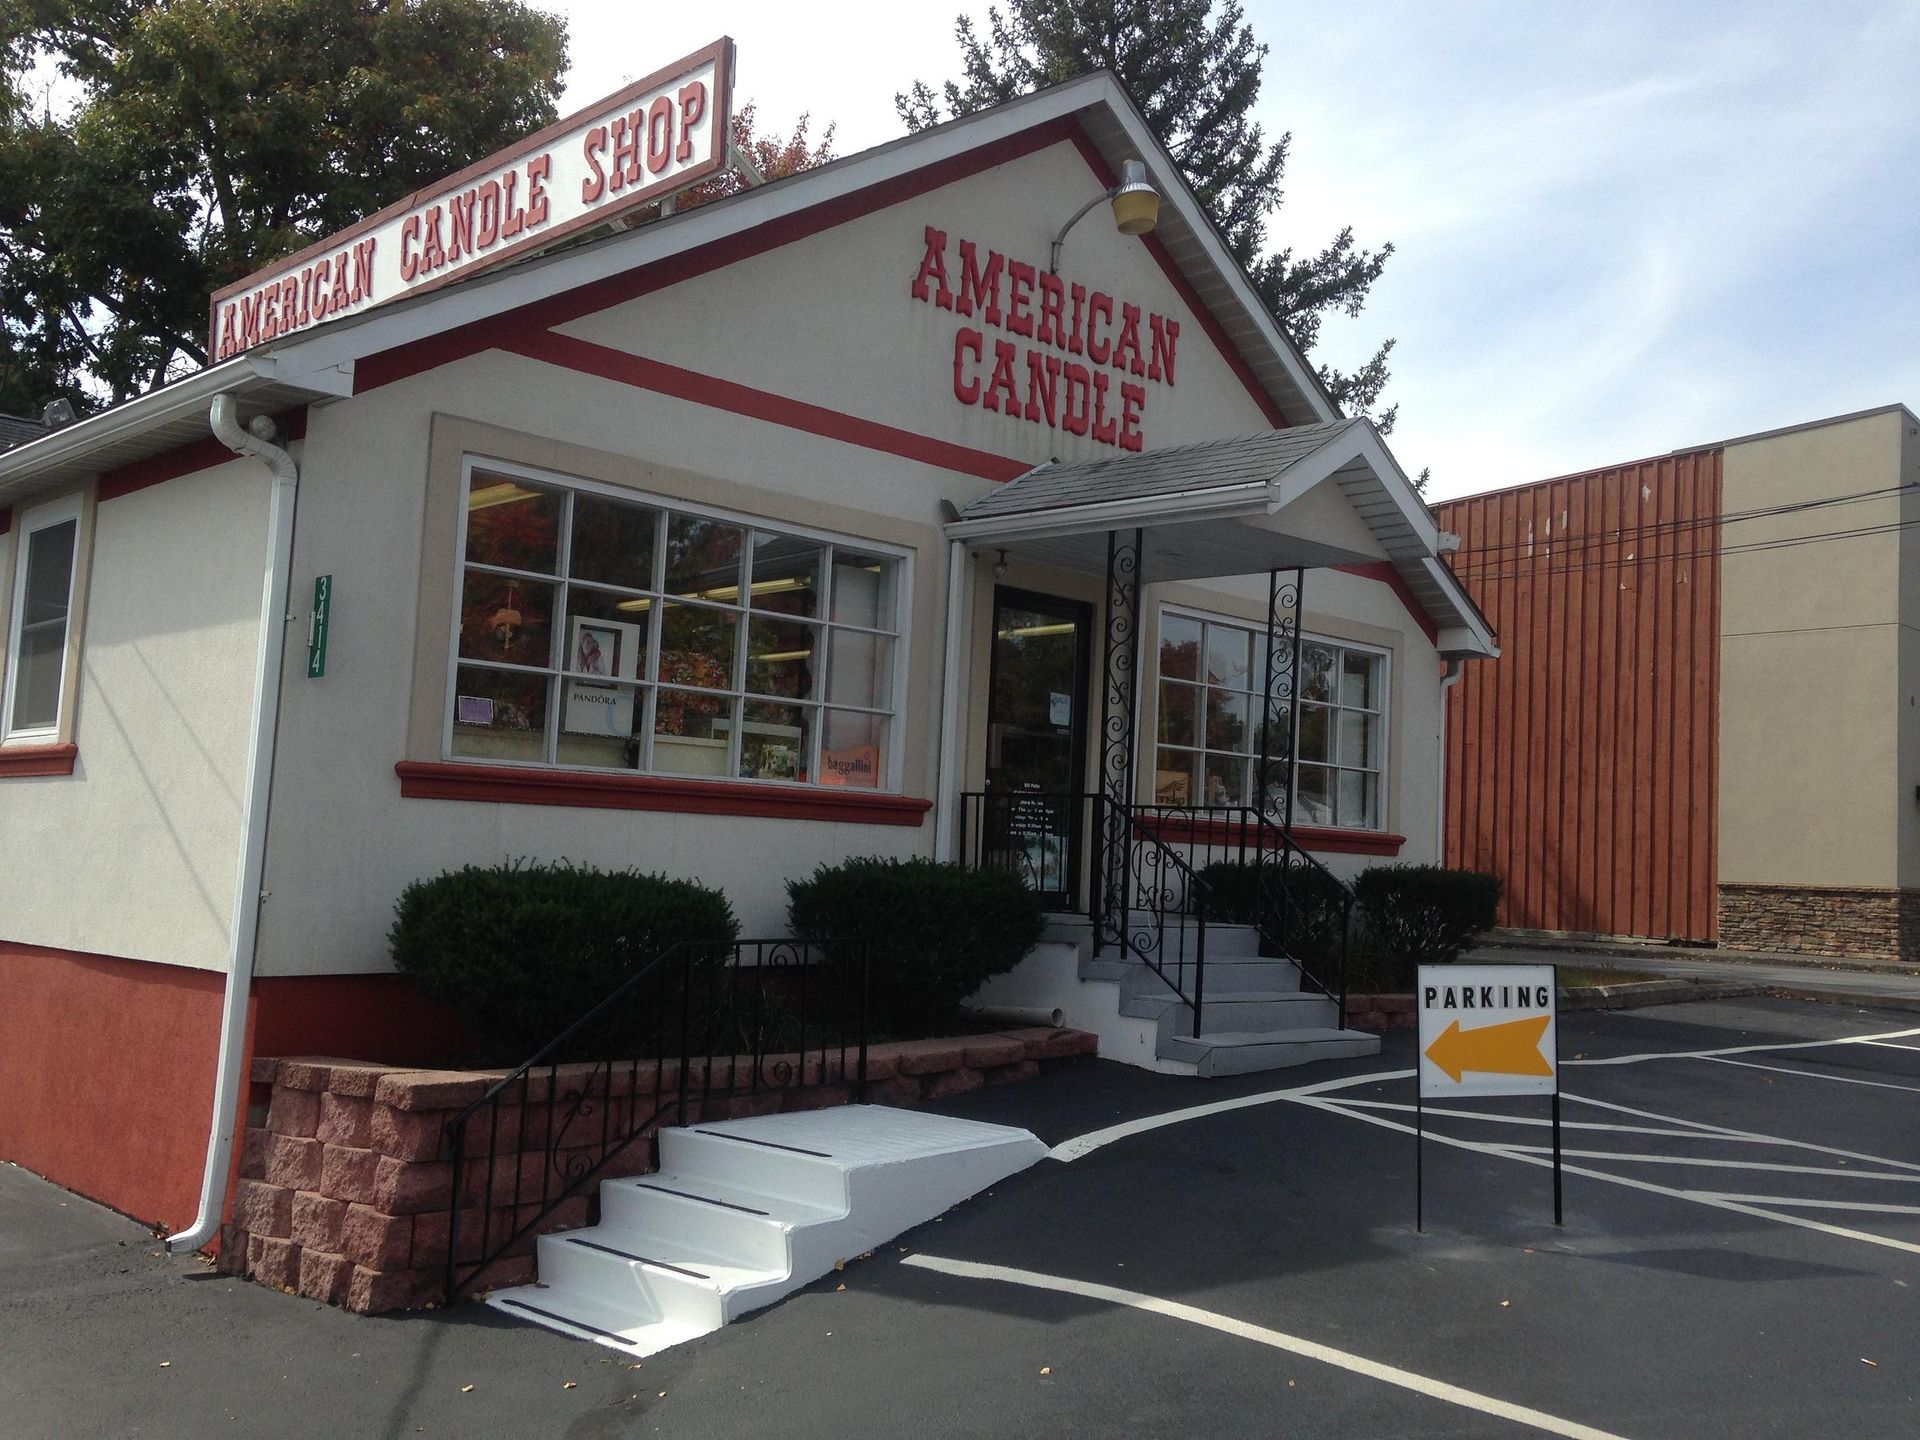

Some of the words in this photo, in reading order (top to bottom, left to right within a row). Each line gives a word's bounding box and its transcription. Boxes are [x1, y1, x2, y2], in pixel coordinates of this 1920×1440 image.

[218, 237, 376, 357] AMERICAN
[399, 153, 551, 282] CANDLE
[582, 81, 706, 204] SHOP
[911, 226, 1180, 387] AMERICAN
[953, 327, 1146, 453] CANDLE
[311, 576, 327, 673] 3414
[573, 693, 617, 706] PANDORA
[827, 756, 872, 776] baggallini
[1424, 986, 1549, 1009] PARKING
